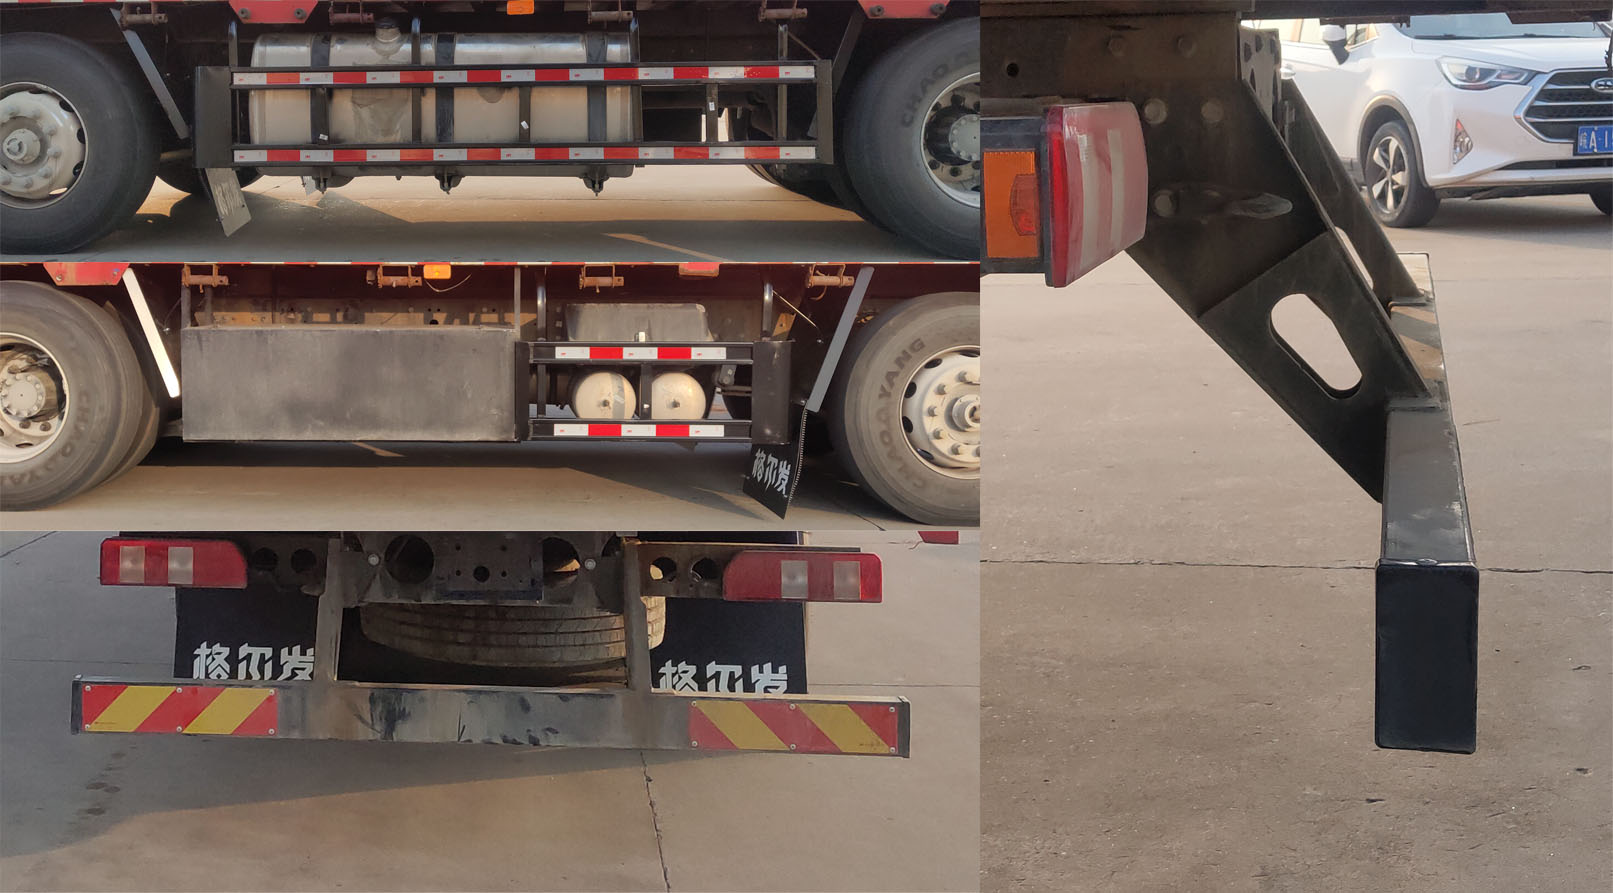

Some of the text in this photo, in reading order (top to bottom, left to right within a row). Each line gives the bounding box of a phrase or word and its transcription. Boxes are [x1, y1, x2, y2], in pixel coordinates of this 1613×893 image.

[752, 448, 791, 496] 格尔发
[193, 641, 315, 681] 格尔发
